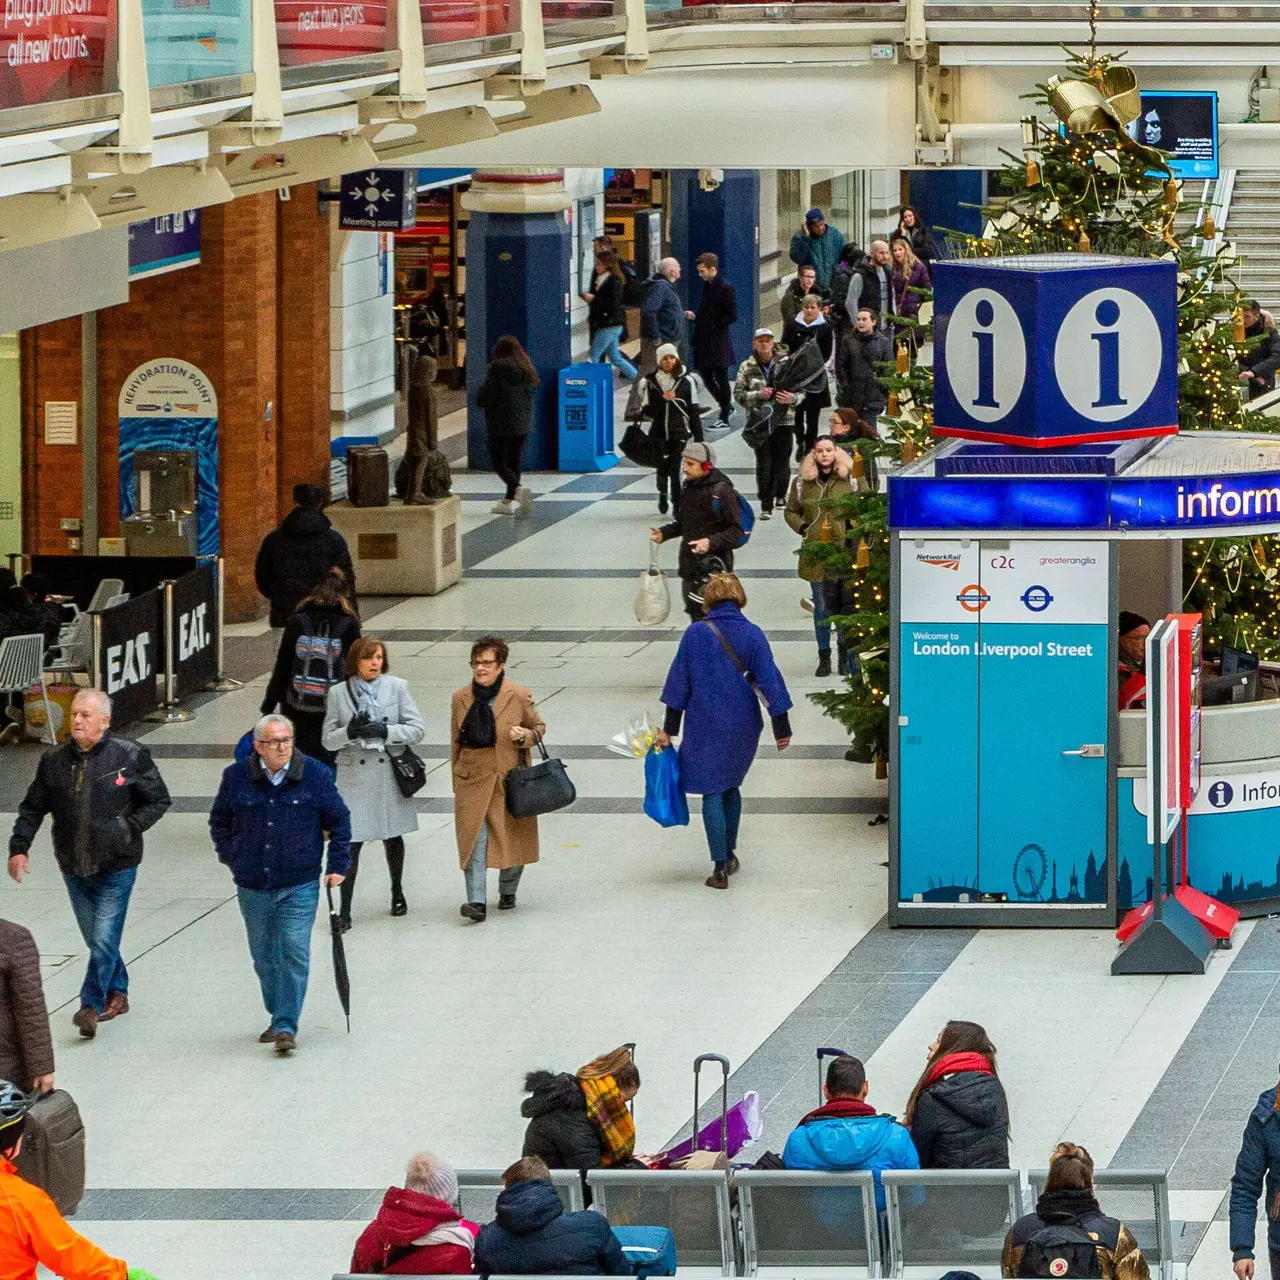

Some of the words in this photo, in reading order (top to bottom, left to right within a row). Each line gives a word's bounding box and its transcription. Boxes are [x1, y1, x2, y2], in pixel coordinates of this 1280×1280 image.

[8, 41, 25, 67] all
[25, 41, 50, 64] new
[52, 30, 89, 61] trains.
[343, 217, 376, 227] Meeting
[377, 219, 399, 229] point
[124, 364, 188, 405] REHYDRATION
[188, 372, 212, 404] POINT
[991, 556, 1014, 569] c2c
[1039, 557, 1096, 566] greateranglia
[179, 602, 210, 663] EAT.
[914, 642, 969, 655] London
[975, 642, 1042, 658] Liverpool
[1047, 643, 1092, 656] Street
[106, 631, 151, 696] EAT.
